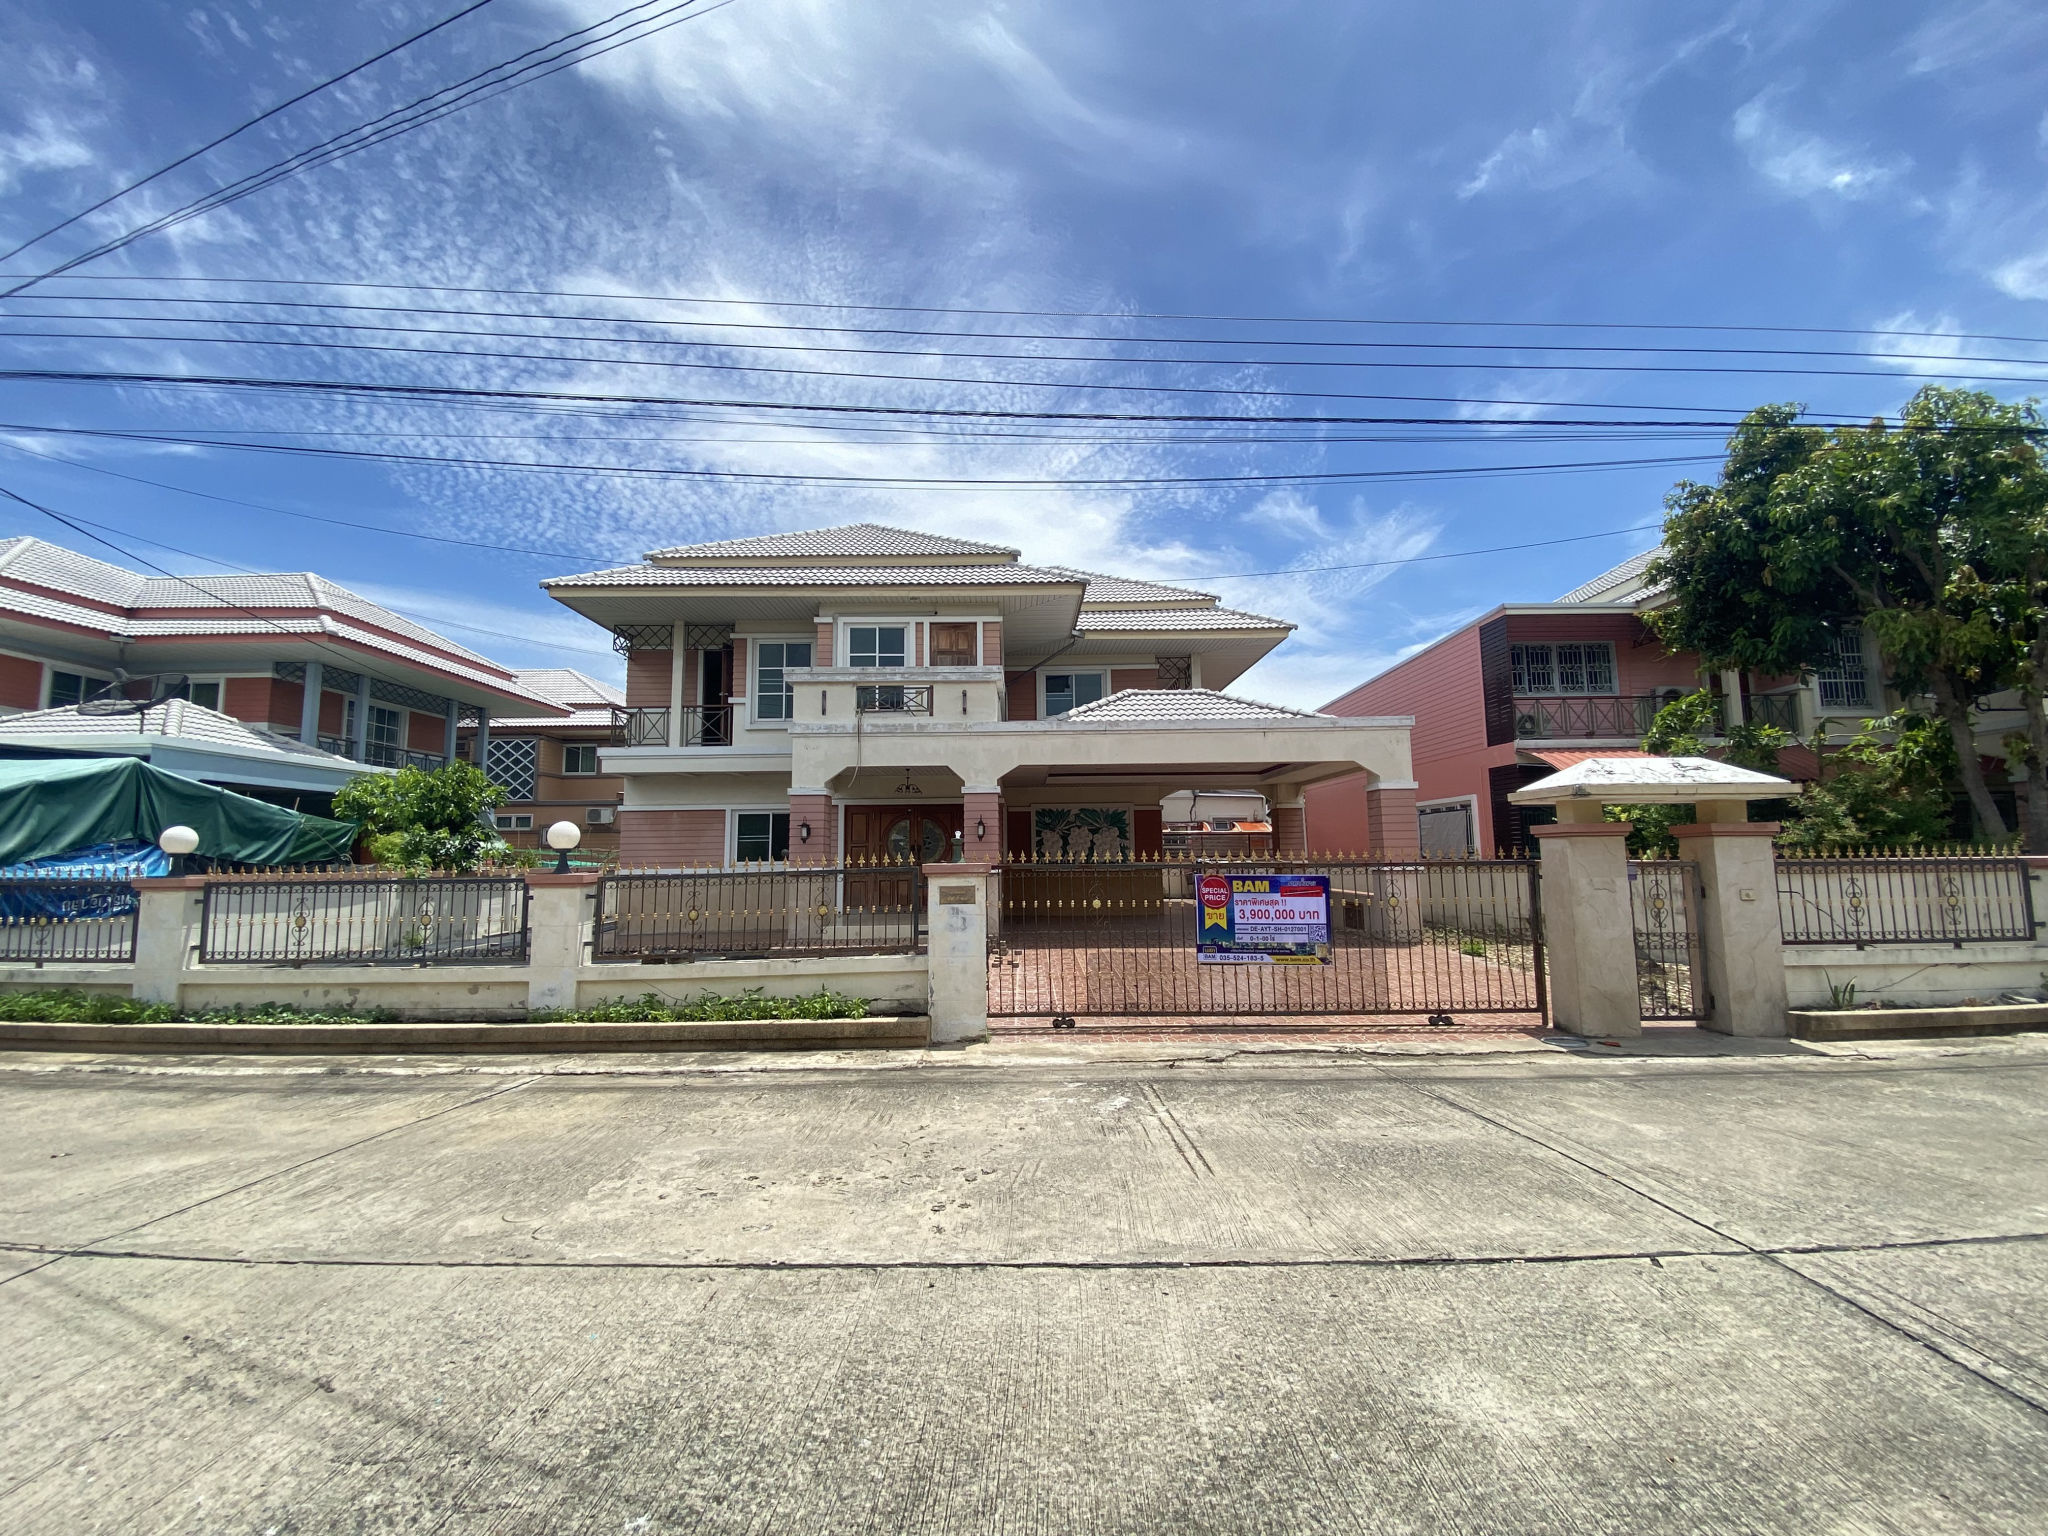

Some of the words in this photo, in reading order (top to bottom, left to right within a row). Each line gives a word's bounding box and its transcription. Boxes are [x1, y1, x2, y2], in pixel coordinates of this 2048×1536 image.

[1233, 881, 1270, 893] BAM
[1234, 898, 1280, 909] ราคาพิเศษสุด
[1206, 912, 1225, 920] ขาย
[1239, 909, 1295, 921] 3,900,000
[1298, 910, 1320, 920] บาท
